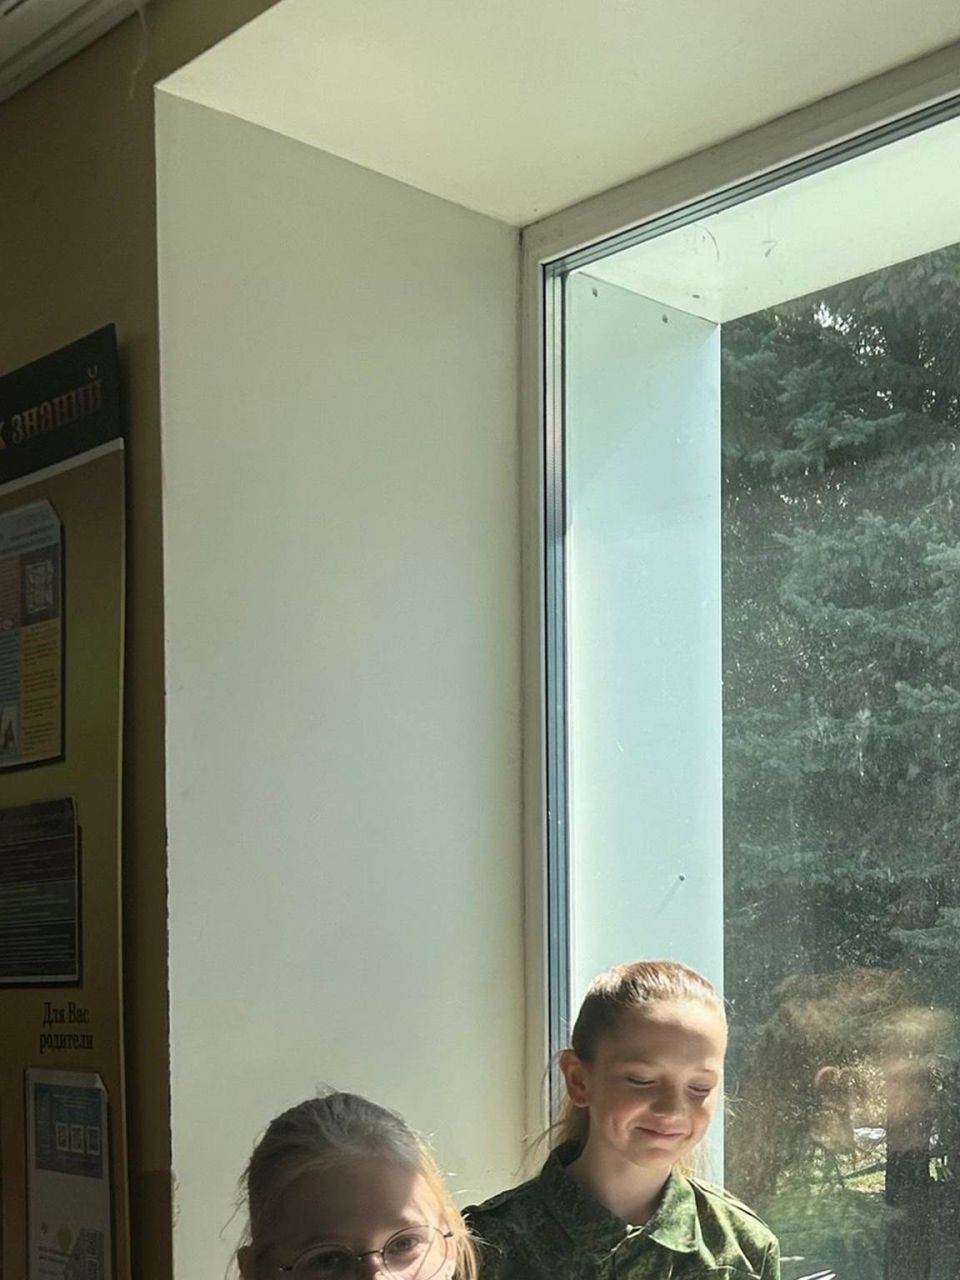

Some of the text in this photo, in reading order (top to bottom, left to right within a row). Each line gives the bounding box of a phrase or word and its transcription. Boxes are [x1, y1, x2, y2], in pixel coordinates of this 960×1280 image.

[43, 1002, 89, 1028] Для Вас
[39, 1033, 94, 1054] родители
